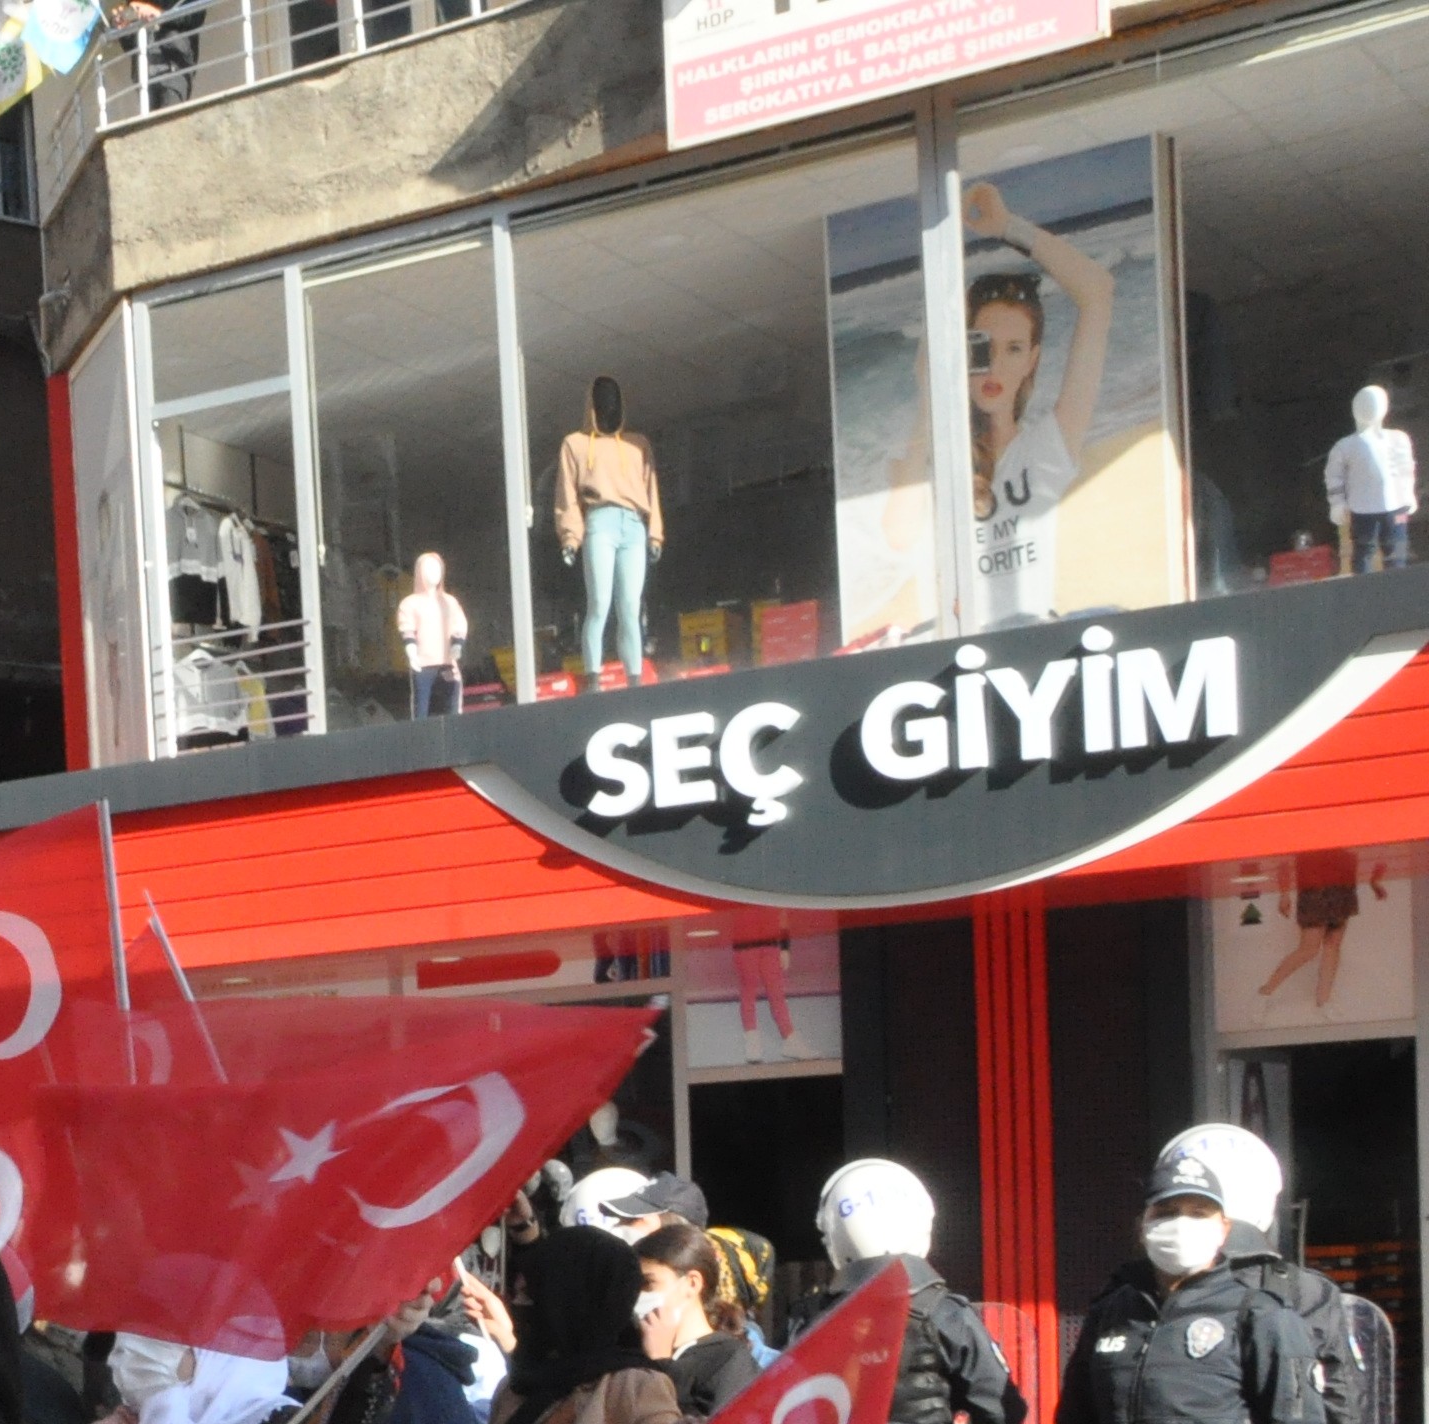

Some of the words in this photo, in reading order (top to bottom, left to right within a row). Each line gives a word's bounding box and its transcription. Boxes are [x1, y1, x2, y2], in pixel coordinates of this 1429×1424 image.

[695, 8, 735, 32] HDP
[676, 40, 809, 88] HALKLARIN
[739, 56, 827, 97] ŞIRNAK
[864, 8, 1017, 63] BAŞKANLIĞI
[993, 515, 1021, 541] MY
[977, 541, 1038, 575] ORITE
[584, 701, 804, 827] SEÇ
[859, 624, 1239, 783] GİYİM
